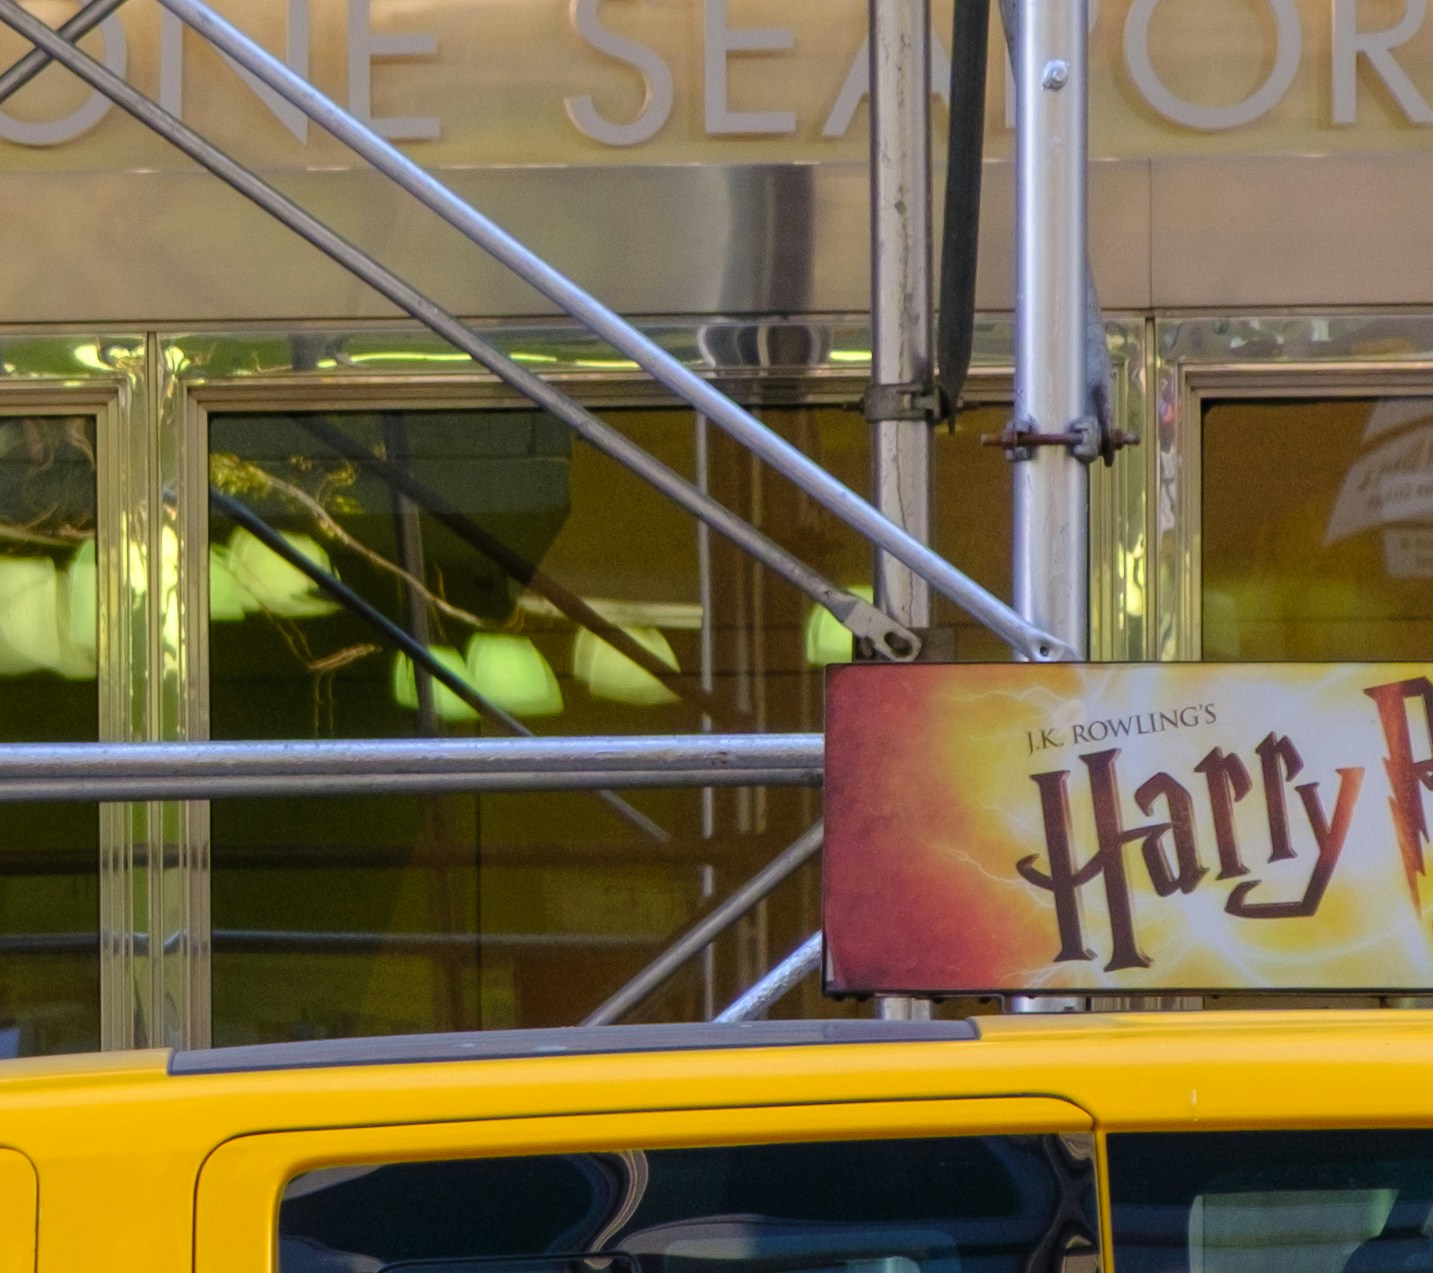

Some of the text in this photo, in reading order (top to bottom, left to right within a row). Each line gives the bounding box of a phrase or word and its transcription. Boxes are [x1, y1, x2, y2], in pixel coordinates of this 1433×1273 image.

[1027, 703, 1217, 756] J.K. ROWLING'S
[1016, 731, 1365, 972] Harry
